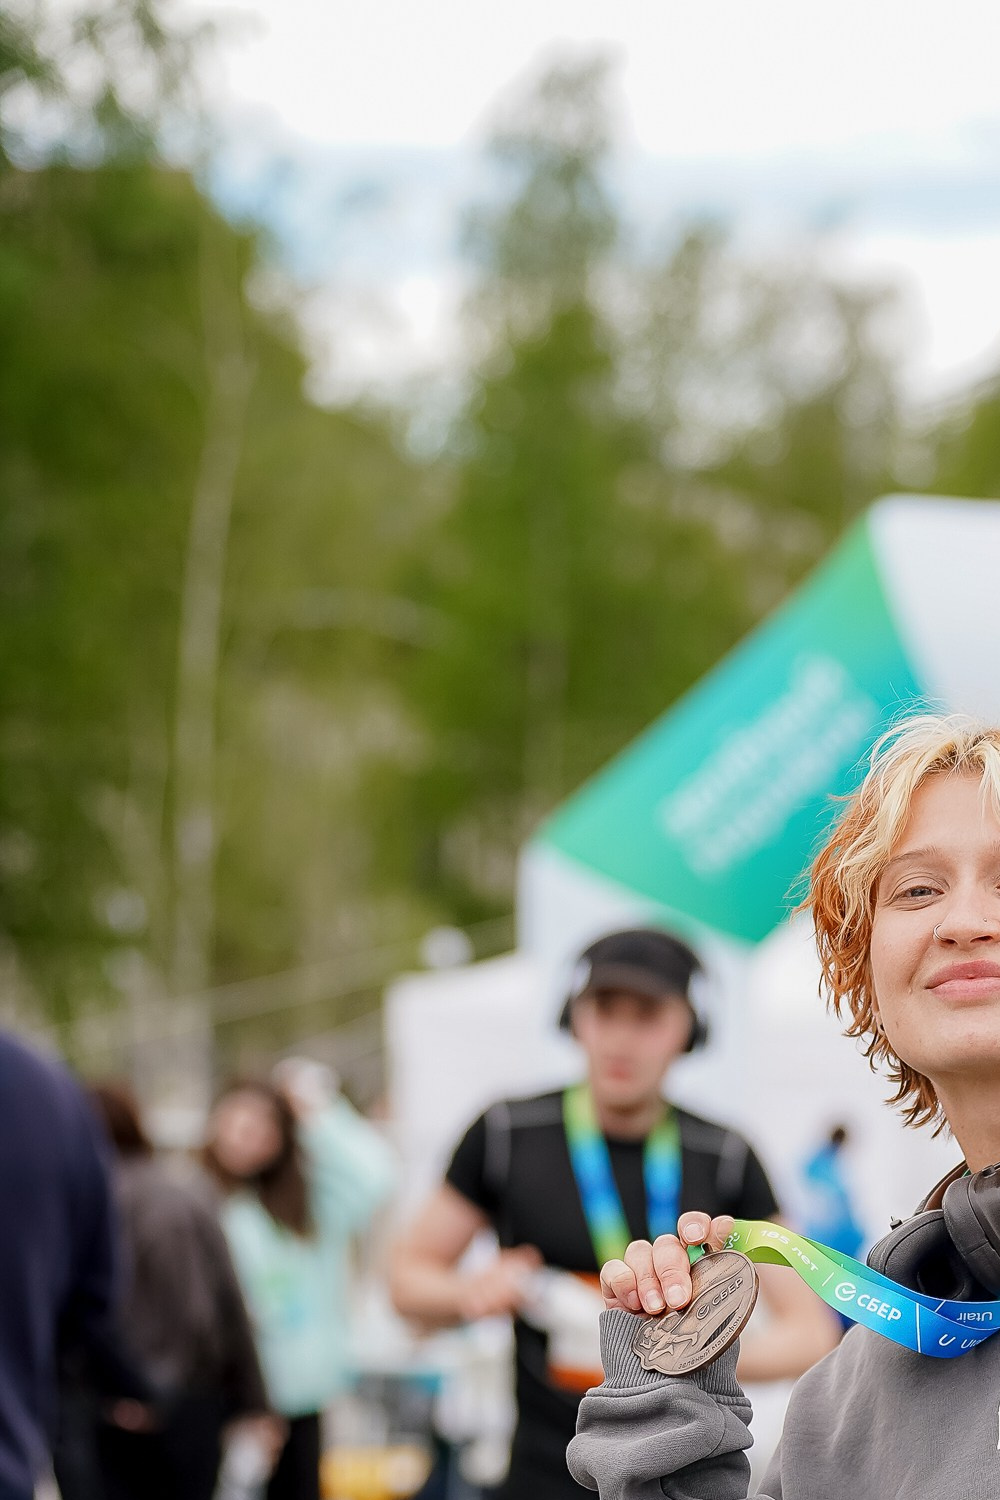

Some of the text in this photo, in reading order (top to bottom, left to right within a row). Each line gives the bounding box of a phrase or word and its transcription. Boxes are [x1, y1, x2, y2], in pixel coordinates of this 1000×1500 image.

[791, 1246, 819, 1272] лет
[712, 1277, 743, 1306] СБЕР
[857, 1294, 902, 1321] СБЕР
[957, 1311, 993, 1323] Utair
[711, 1316, 742, 1350] марафон
